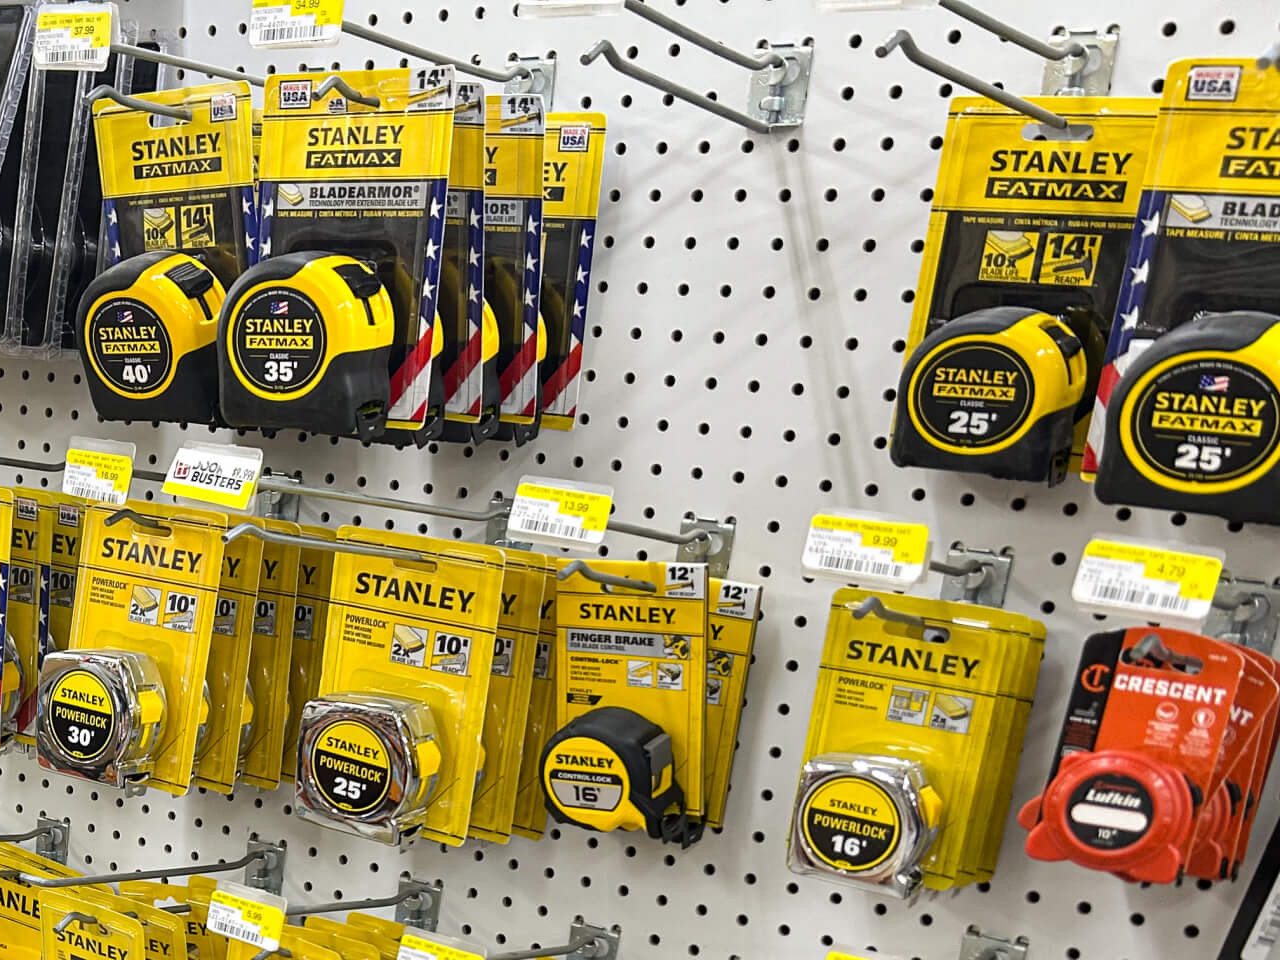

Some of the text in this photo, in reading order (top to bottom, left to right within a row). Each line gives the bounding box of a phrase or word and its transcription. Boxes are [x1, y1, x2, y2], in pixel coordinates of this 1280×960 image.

[417, 67, 445, 89] 14'
[1192, 80, 1231, 93] USA
[282, 91, 309, 103] USA
[213, 105, 234, 117] USA
[308, 125, 404, 146] STANLEY
[562, 134, 586, 146] USA
[131, 132, 220, 161] STANLEY
[142, 158, 212, 177] FATMAX
[310, 151, 398, 167] FATMAX
[990, 150, 1132, 175] STANLEY
[992, 181, 1120, 199] FATMAX
[309, 199, 343, 207] TECHNOLOGY
[182, 207, 211, 226] 14'
[1221, 217, 1279, 228] TECHNOLOGY
[145, 228, 167, 241] 10x
[1166, 229, 1225, 240] TAPE MEASURE
[1235, 232, 1258, 241] CINTA
[1049, 235, 1096, 259] 14'
[984, 253, 1017, 269] 10x
[99, 326, 156, 340] STANLEY
[245, 319, 313, 334] STANLEY
[105, 343, 159, 352] FATMAX
[249, 338, 310, 347] FATMAX
[122, 364, 151, 384] 40'
[264, 361, 298, 382] 35'
[934, 367, 1018, 386] STANLEY
[937, 386, 1013, 397] FATMAX
[1155, 392, 1266, 418] STANLEY
[948, 411, 997, 434] 25'
[1157, 415, 1258, 432] FATMAX
[1187, 434, 1219, 445] CLASSIC
[1174, 445, 1231, 471] 25'
[191, 471, 243, 491] BUSTERS
[18, 503, 36, 516] USA
[563, 500, 589, 513] 13.99
[872, 534, 898, 548] 9.99
[102, 537, 202, 574] STANLEY
[669, 566, 694, 581] 12'
[1157, 565, 1186, 577] 4.79
[92, 576, 127, 590] POWERLOCK
[722, 584, 747, 600] 12'
[355, 572, 475, 614] STANLEY
[168, 593, 196, 612] 10'
[345, 613, 388, 629] POWERLOCK
[580, 603, 676, 625] STANLEY
[436, 635, 469, 656] 10'
[570, 632, 654, 647] FINGER BRAKE
[846, 638, 977, 679] STANLEY
[838, 677, 884, 692] POWERLOCK
[1114, 673, 1226, 706] CRESCENT
[61, 687, 104, 706] STANLEY
[55, 706, 107, 730] POWERLOCK
[67, 726, 95, 747] 30'
[326, 736, 378, 761] STANLEY
[320, 755, 382, 784] POWERLOCK
[555, 752, 613, 769] STANLEY
[557, 770, 612, 783] CONTROL-LOCK
[333, 776, 367, 800] 25'
[572, 784, 601, 803] 16'
[829, 797, 878, 818] STANLEY
[1086, 790, 1141, 808] Lufkin
[813, 813, 887, 841] POWERLOCK
[831, 834, 867, 857] 16'
[246, 910, 263, 921] 5.99
